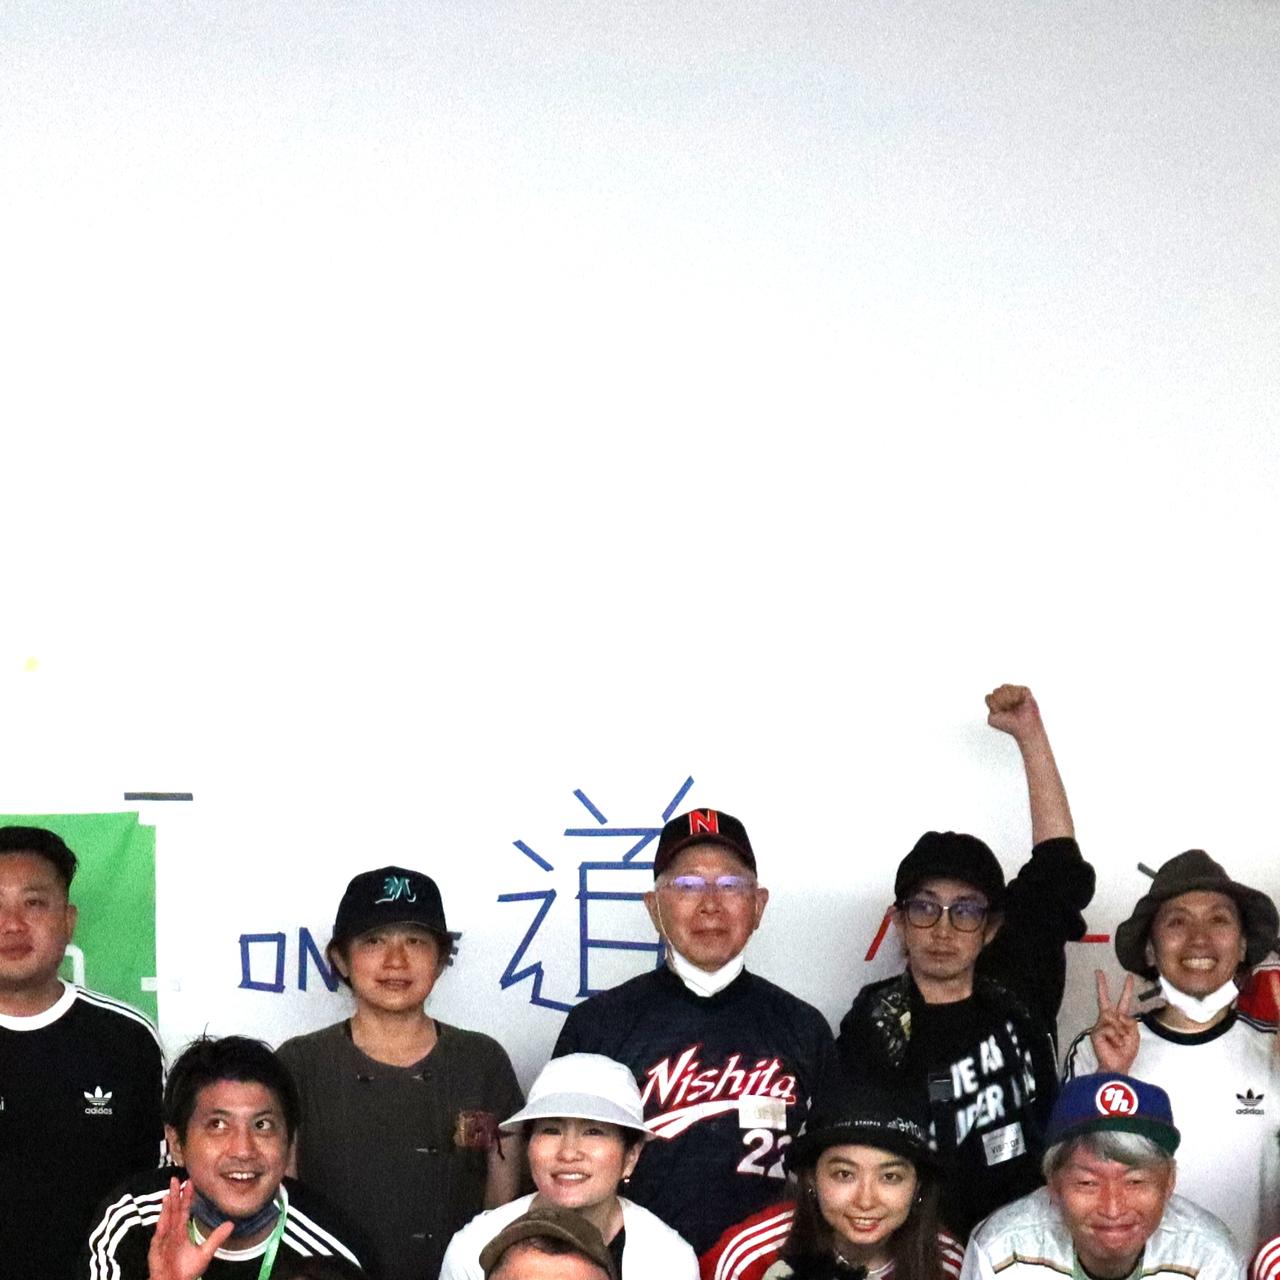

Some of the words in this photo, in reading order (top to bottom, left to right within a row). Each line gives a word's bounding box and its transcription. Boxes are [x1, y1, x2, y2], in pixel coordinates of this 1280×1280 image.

[689, 808, 719, 835] N
[84, 1106, 113, 1116] adidas
[1235, 1107, 1265, 1116] adidas
